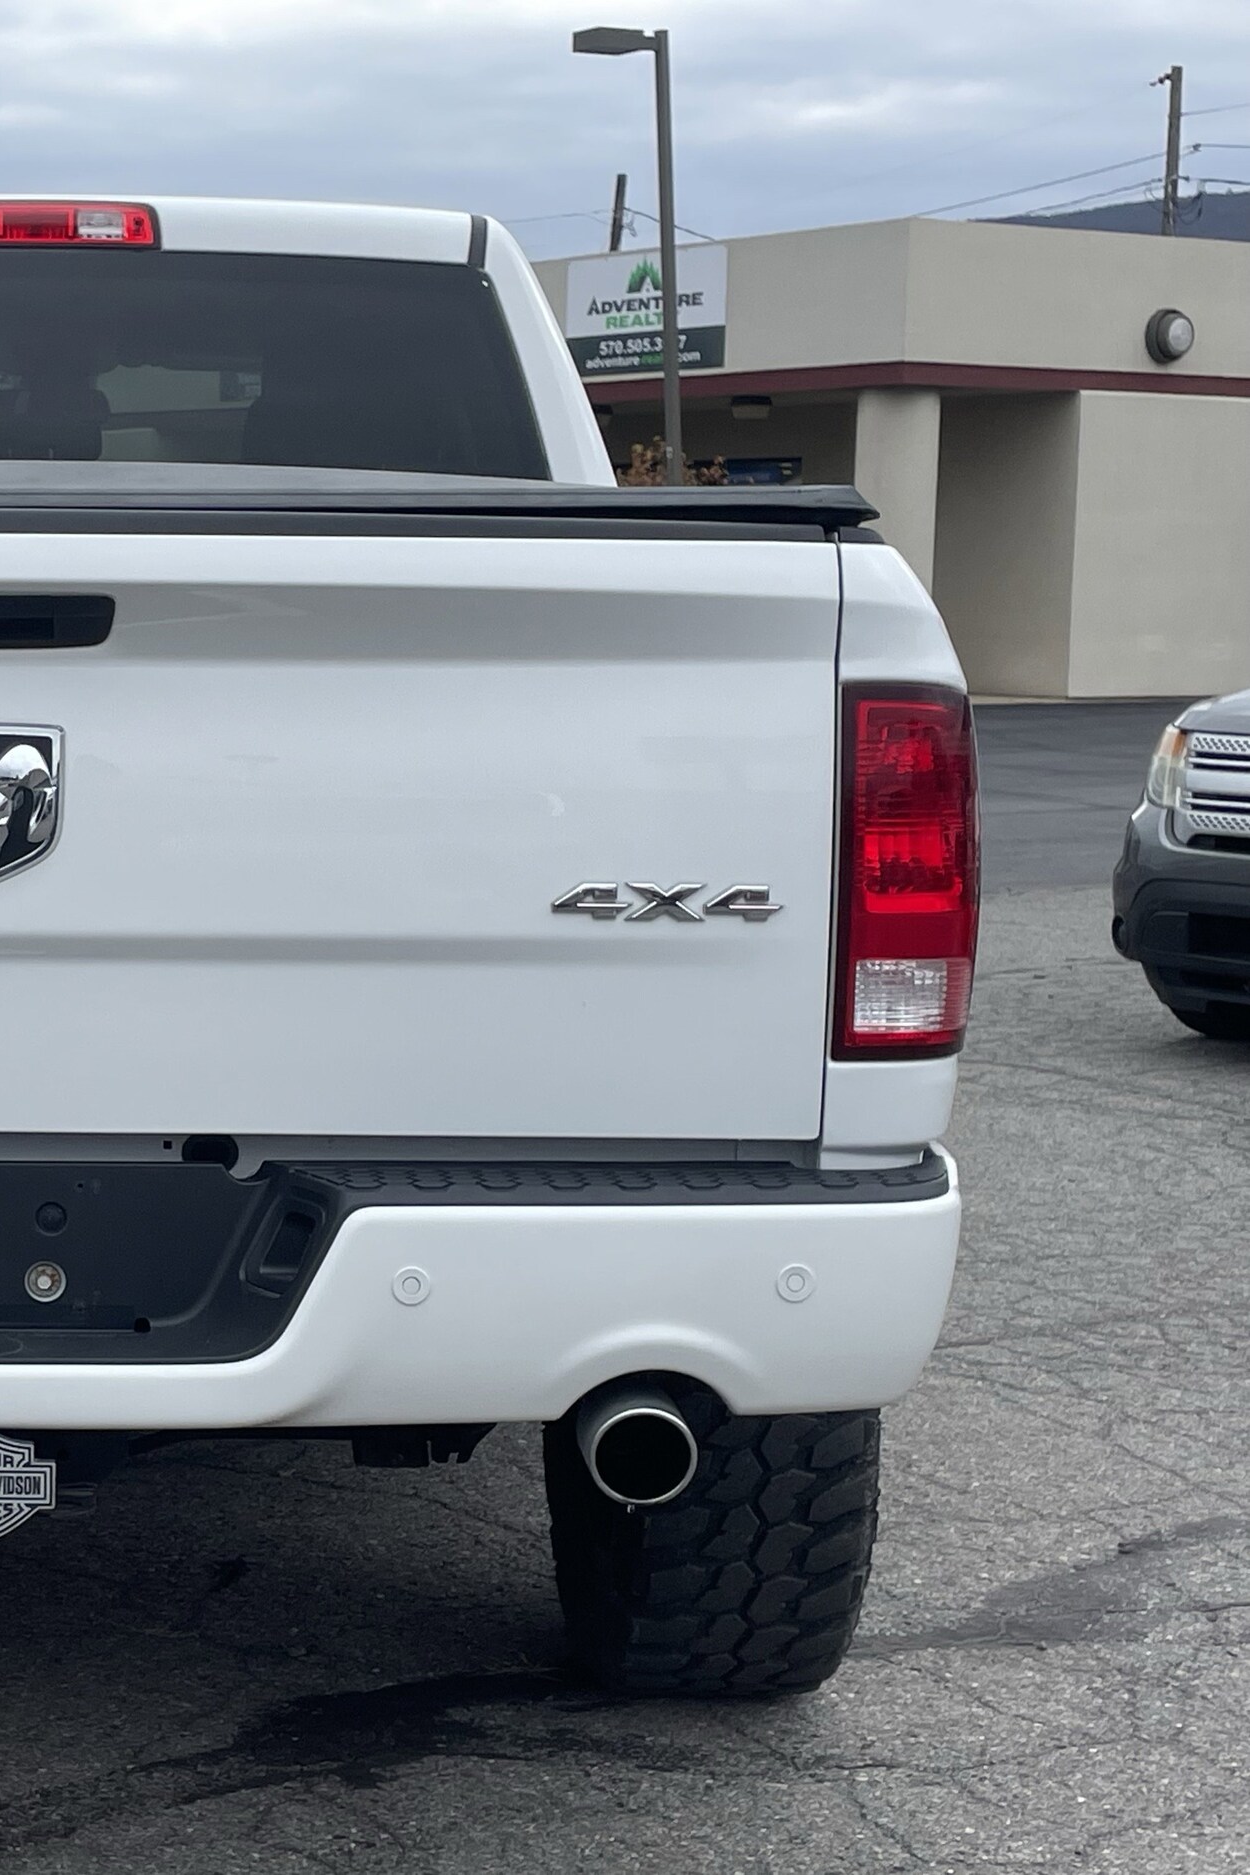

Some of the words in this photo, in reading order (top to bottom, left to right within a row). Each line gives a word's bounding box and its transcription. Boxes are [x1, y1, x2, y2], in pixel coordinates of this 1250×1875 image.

[587, 291, 704, 316] ADVENTRE
[605, 312, 664, 330] REALT
[598, 334, 687, 357] 570.505.37
